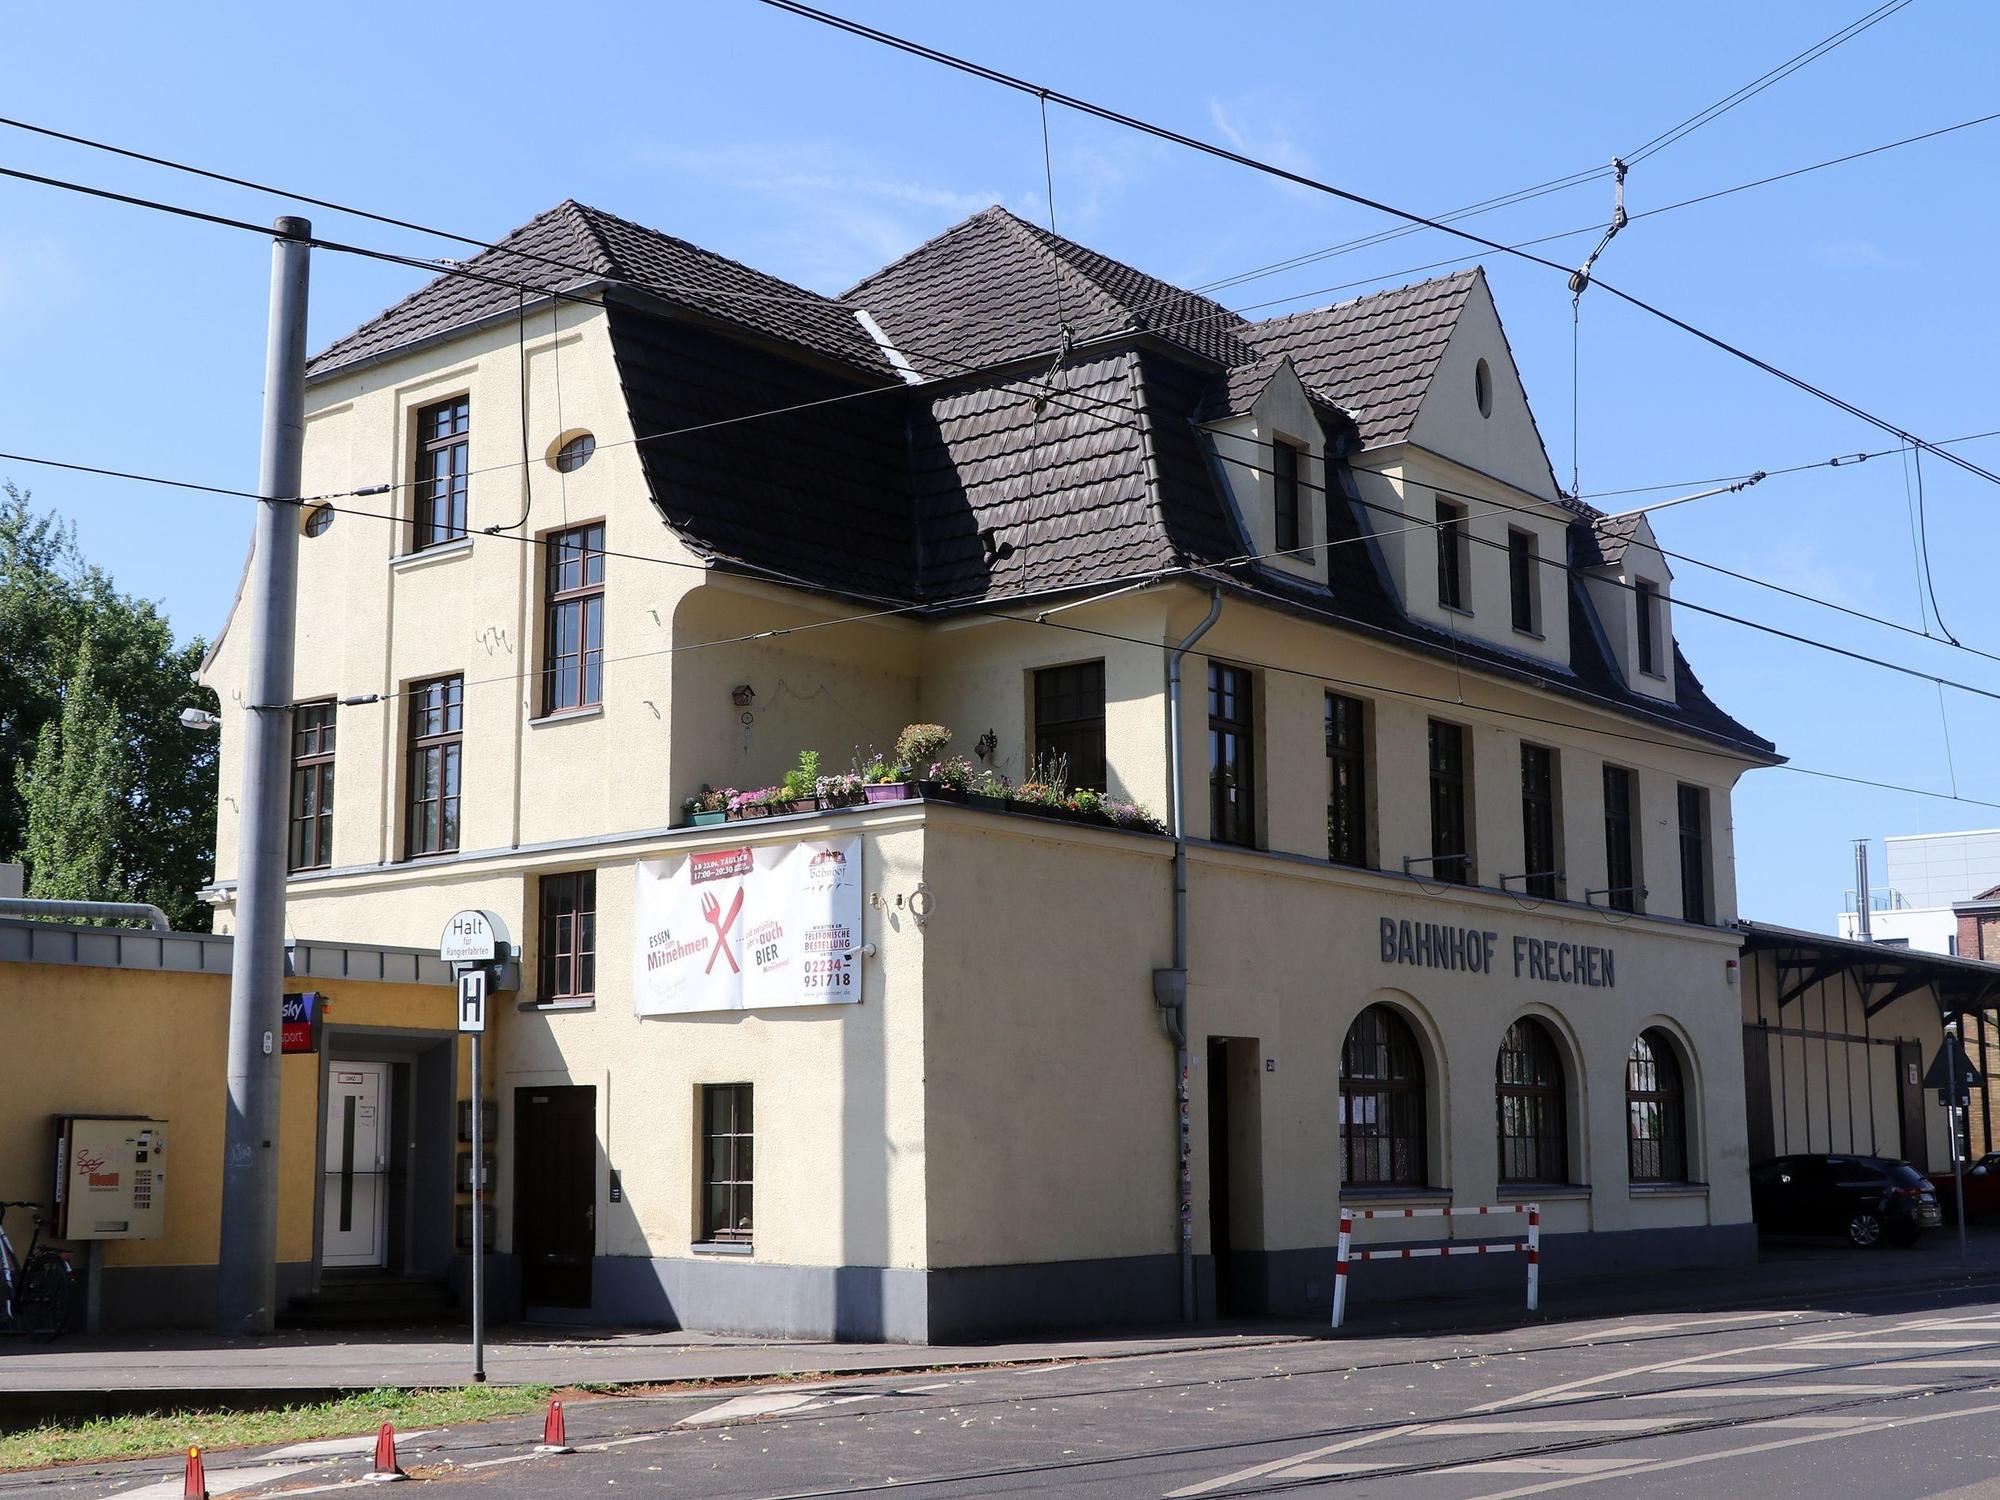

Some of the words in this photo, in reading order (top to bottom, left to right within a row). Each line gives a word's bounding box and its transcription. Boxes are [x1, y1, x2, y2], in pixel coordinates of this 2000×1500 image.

[720, 854, 748, 866] TÄGLICH
[453, 918, 482, 936] Halt
[759, 921, 783, 945] auch
[804, 930, 850, 941] TELEFONISCHE
[649, 929, 671, 948] ESSEN
[804, 939, 850, 951] BESTELLUNG
[647, 936, 708, 971] Mitnehmen
[755, 943, 779, 966] BIER
[1380, 917, 1498, 974] BAHNHOF
[1513, 936, 1616, 988] FRECHEN
[804, 973, 851, 987] 951718
[462, 978, 481, 1022] H
[281, 1000, 303, 1020] sky
